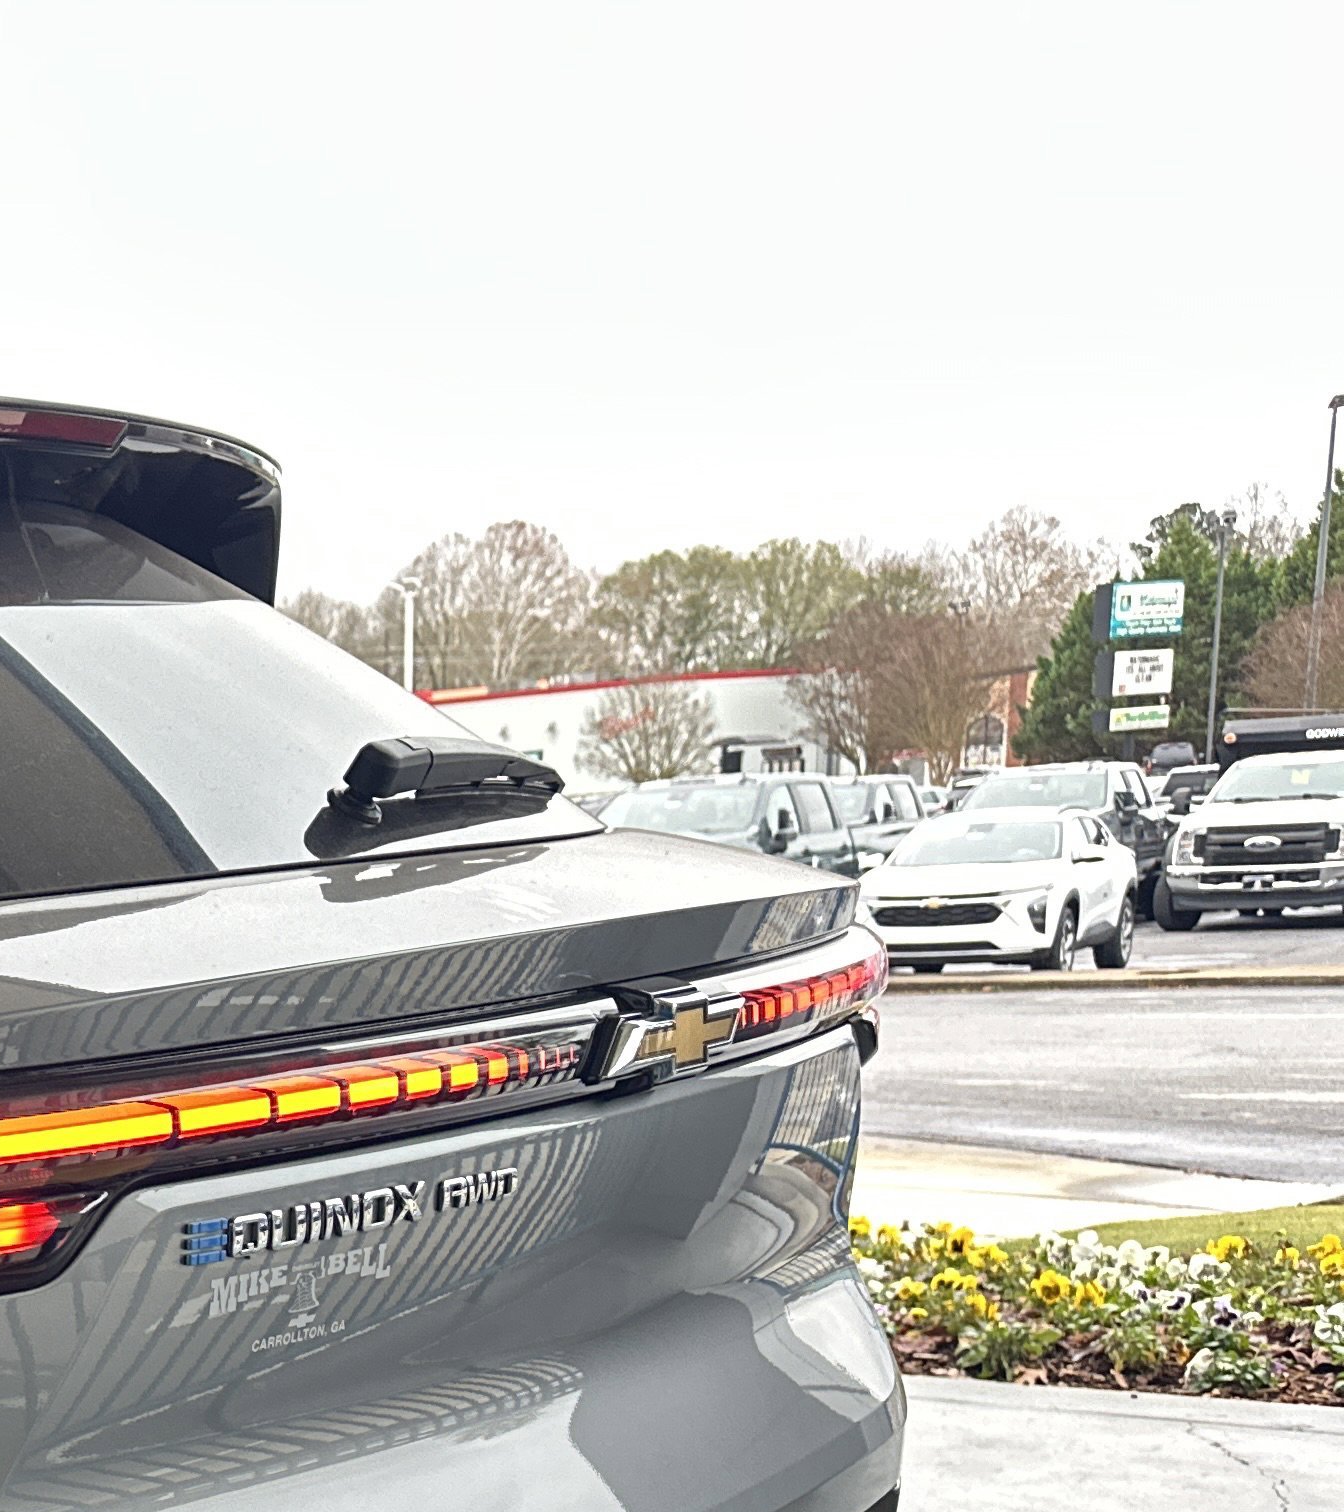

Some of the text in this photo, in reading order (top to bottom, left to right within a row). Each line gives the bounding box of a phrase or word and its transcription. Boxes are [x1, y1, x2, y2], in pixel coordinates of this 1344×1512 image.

[438, 1167, 519, 1213] AWD
[208, 1243, 392, 1320] MIKE BELL
[251, 1319, 346, 1353] CARROLLTON, GA
